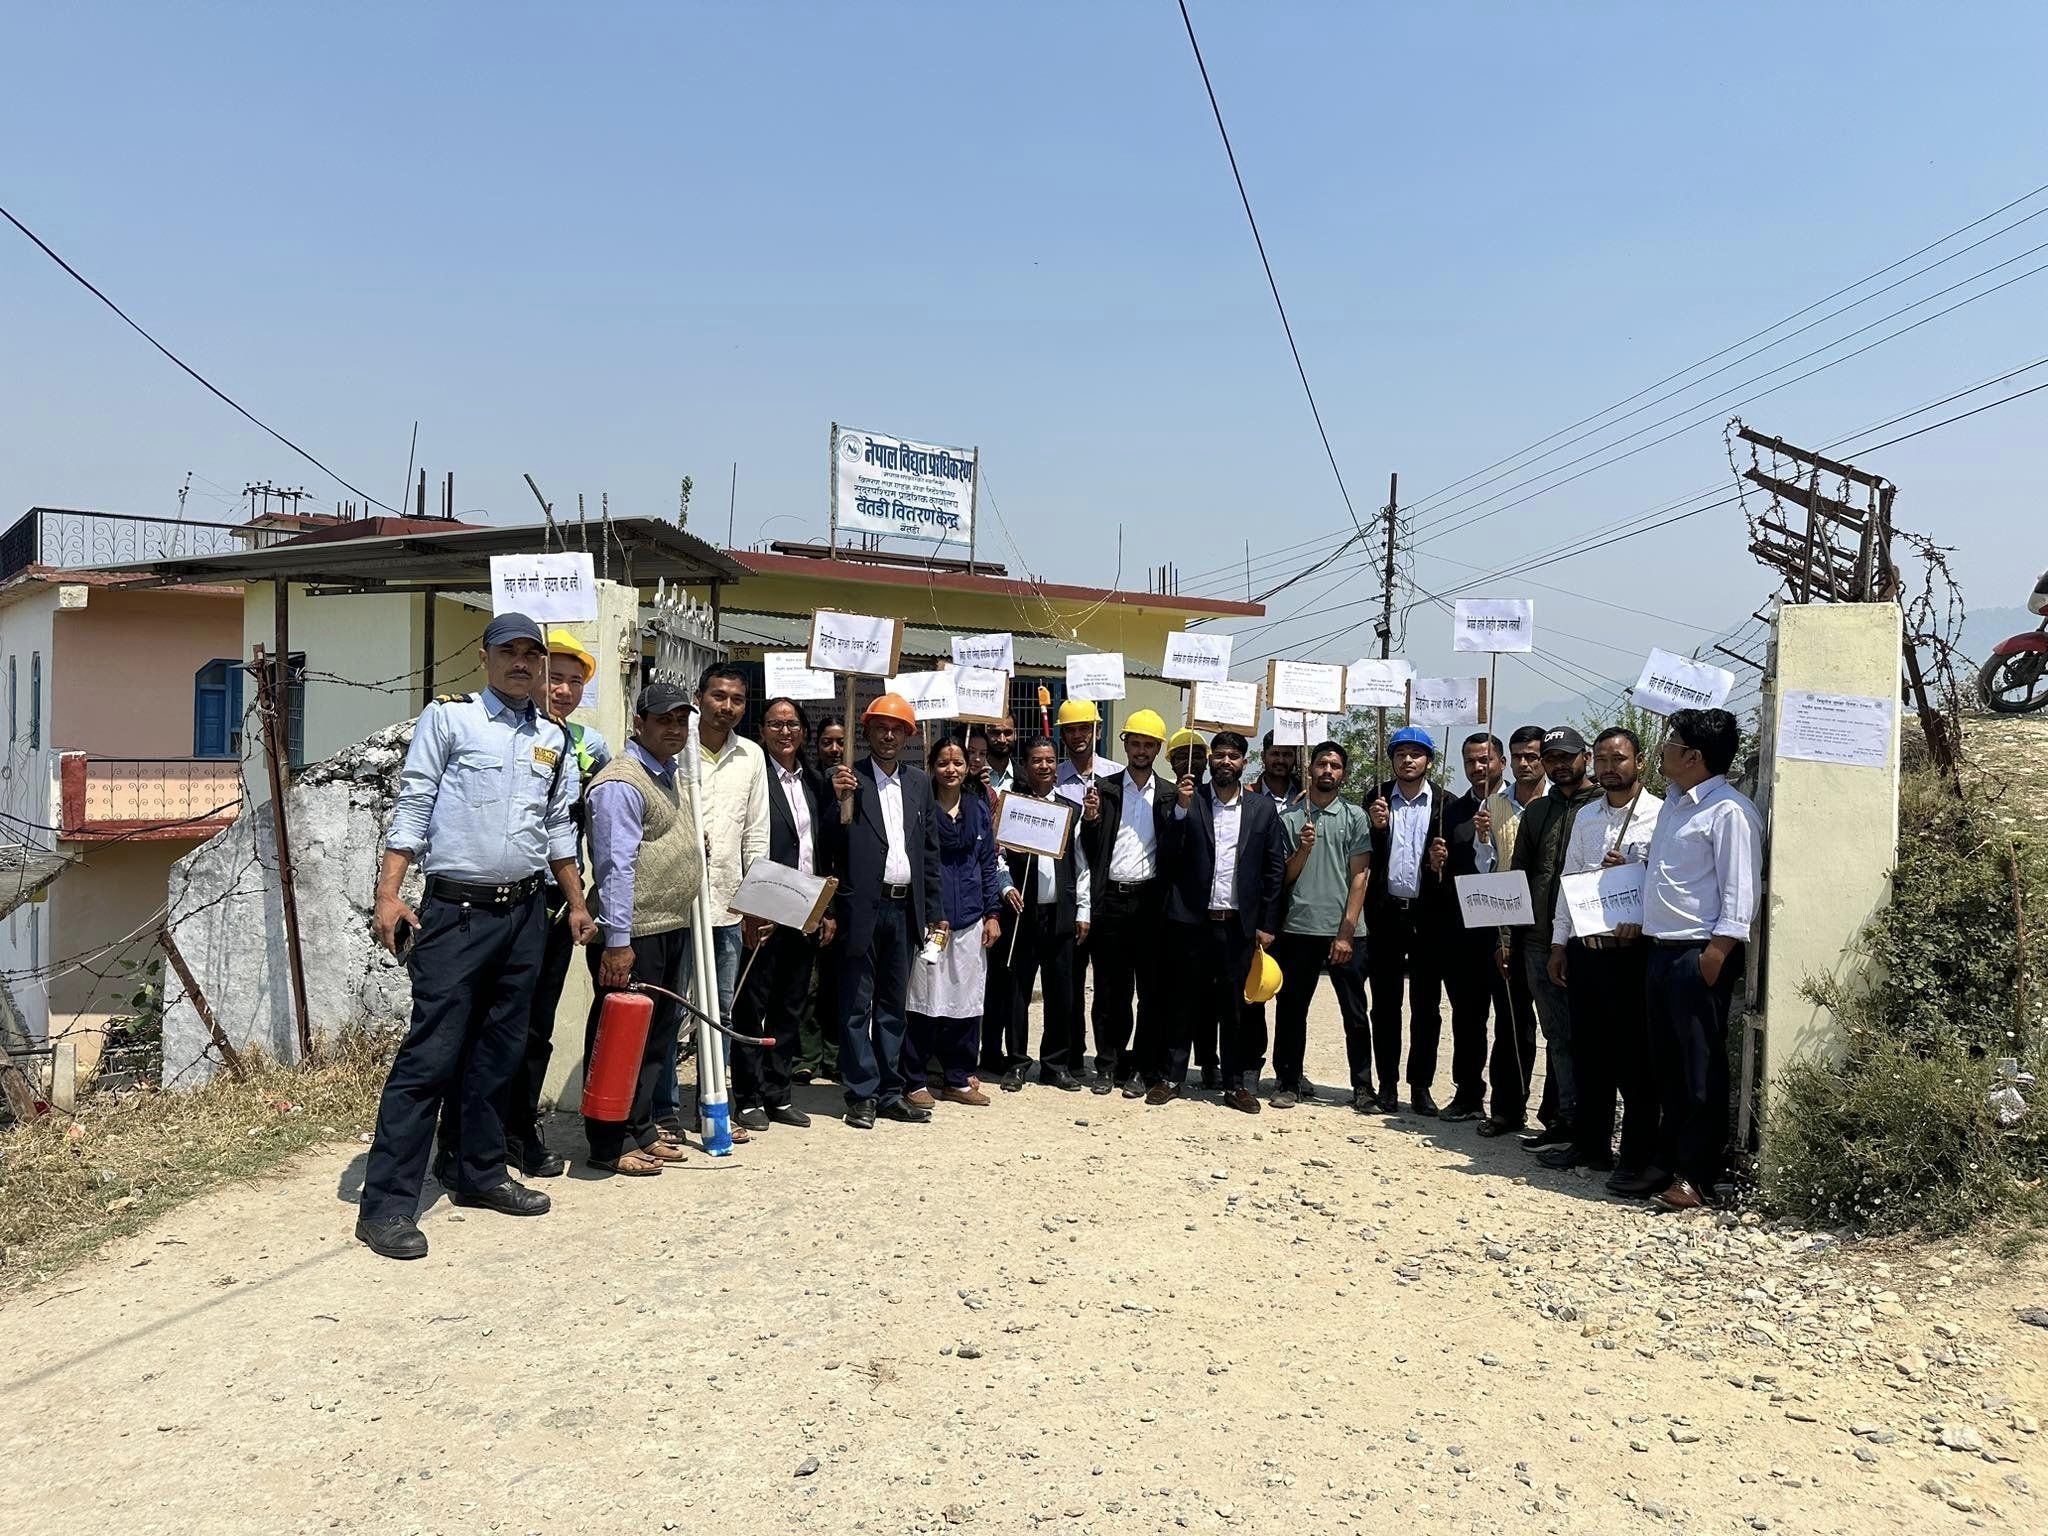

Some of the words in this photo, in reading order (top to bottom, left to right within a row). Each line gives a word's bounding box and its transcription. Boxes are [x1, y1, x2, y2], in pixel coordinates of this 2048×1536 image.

[864, 437, 898, 470] नेपाल
[899, 444, 928, 476] विद्युत
[928, 451, 973, 483] प्राधिकरण
[855, 495, 890, 519] बैतडी
